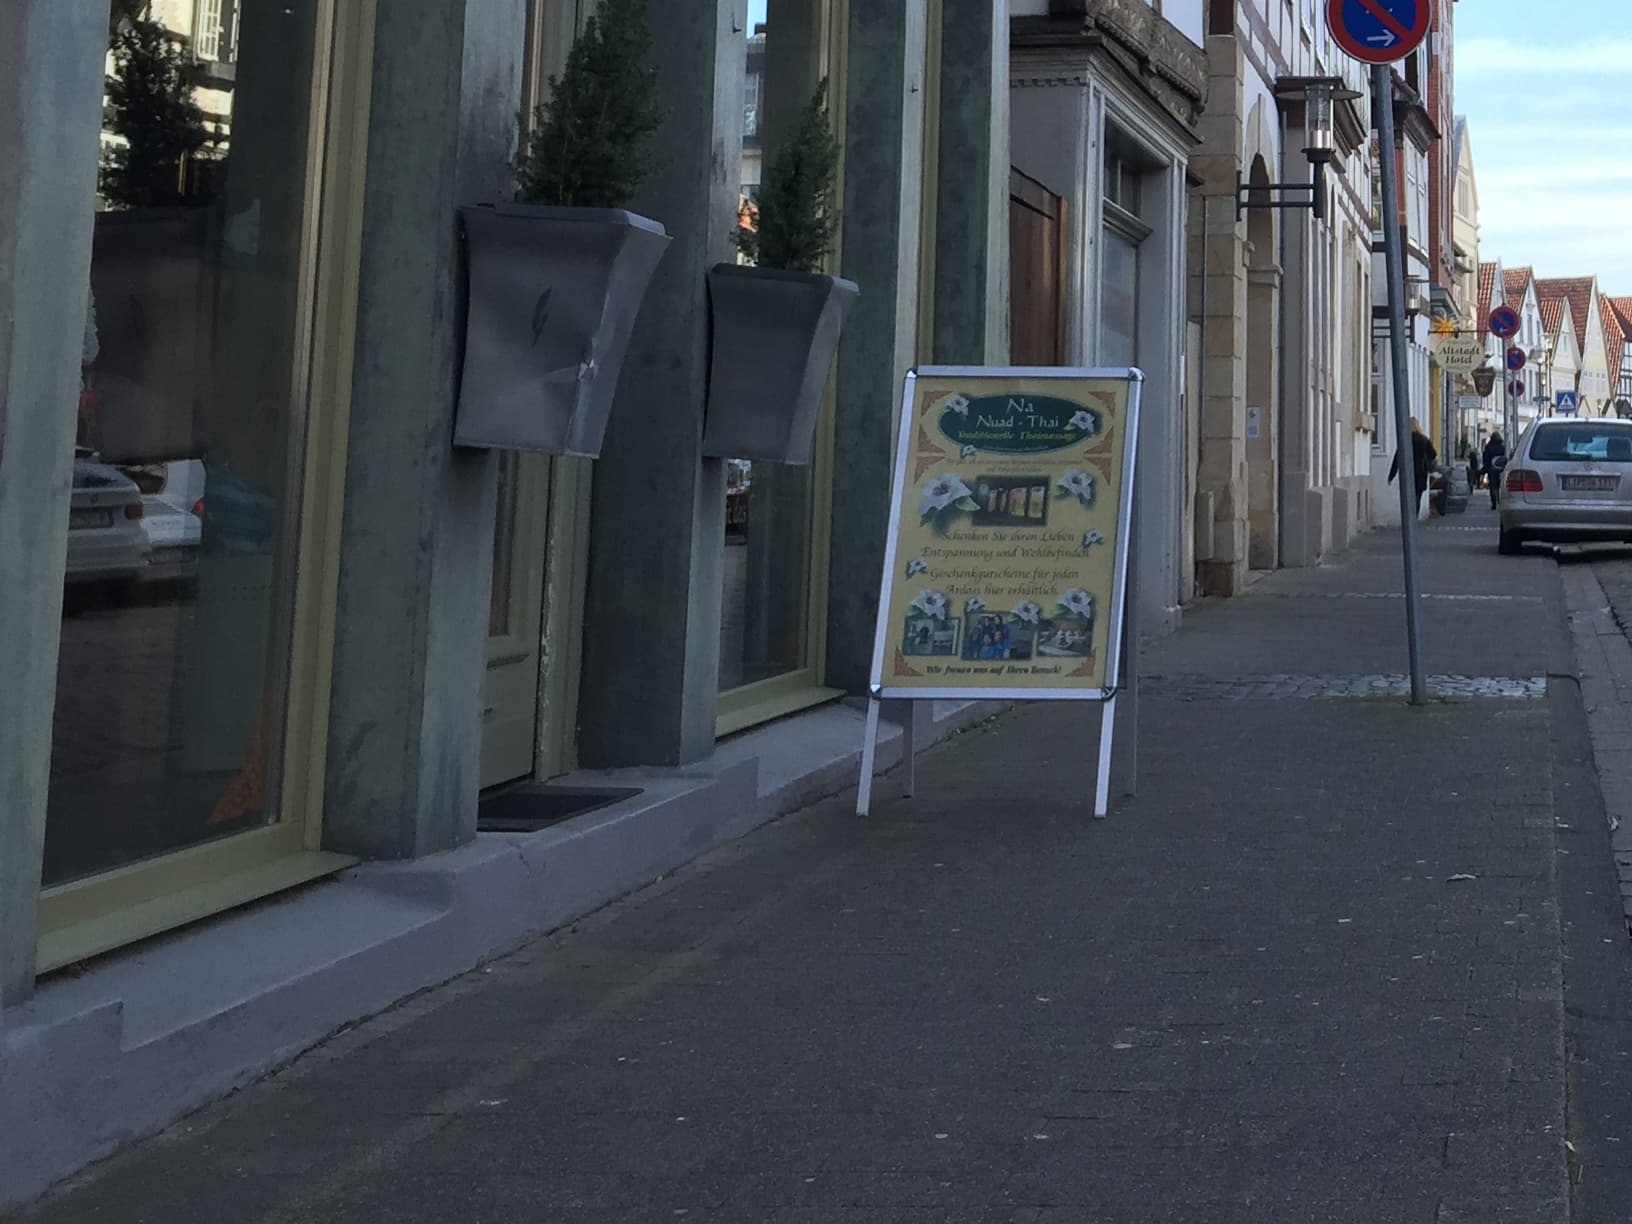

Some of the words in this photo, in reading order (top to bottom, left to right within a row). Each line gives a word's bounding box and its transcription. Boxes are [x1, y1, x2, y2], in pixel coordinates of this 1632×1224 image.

[1440, 346, 1480, 355] Altstadt
[1445, 355, 1472, 364] Hotel
[1006, 397, 1034, 414] Na
[975, 414, 1014, 428] Nuad
[1027, 415, 1059, 428] Thai
[992, 530, 1007, 541] Sie
[996, 547, 1017, 558] und
[983, 583, 1004, 595] hier
